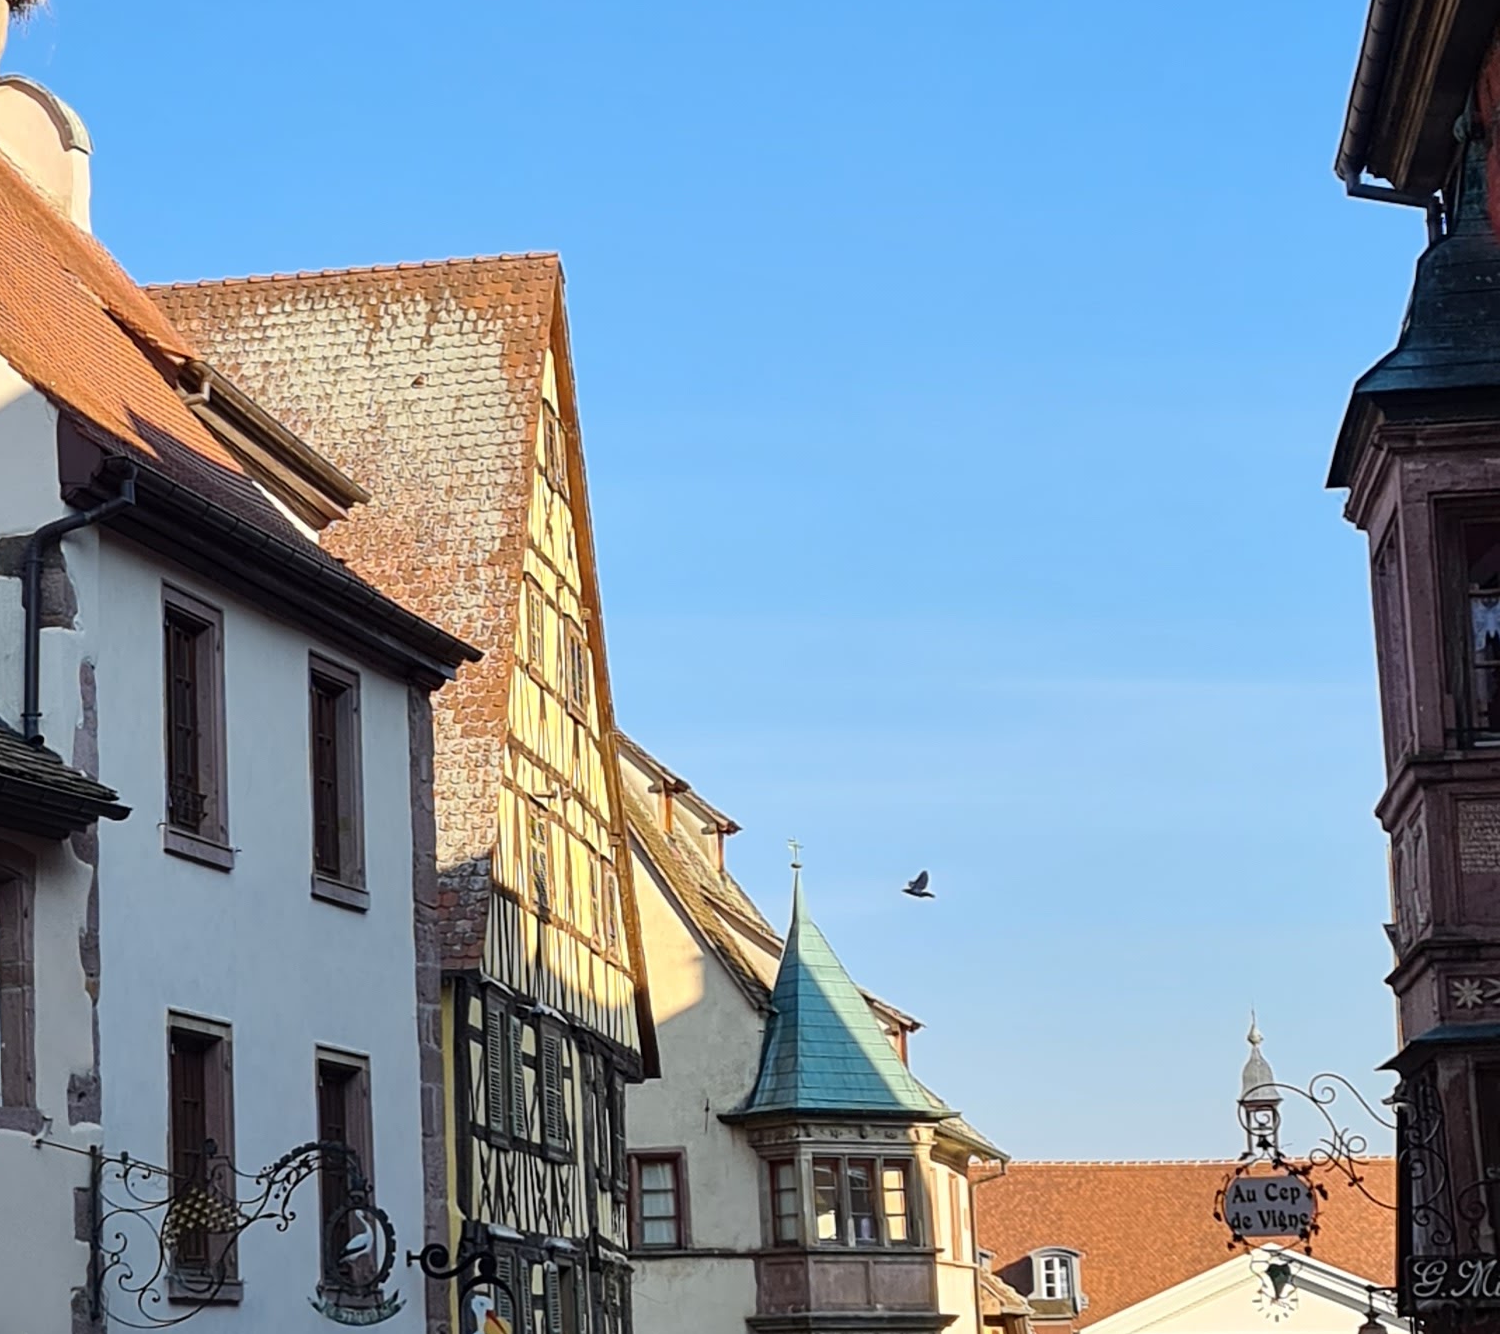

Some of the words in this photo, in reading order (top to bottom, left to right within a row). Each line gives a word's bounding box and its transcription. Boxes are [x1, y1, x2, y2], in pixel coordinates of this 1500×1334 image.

[1232, 1185, 1257, 1204] Au
[1264, 1182, 1301, 1205] Cep
[1231, 1211, 1253, 1230] de
[1257, 1210, 1310, 1232] Vigne
